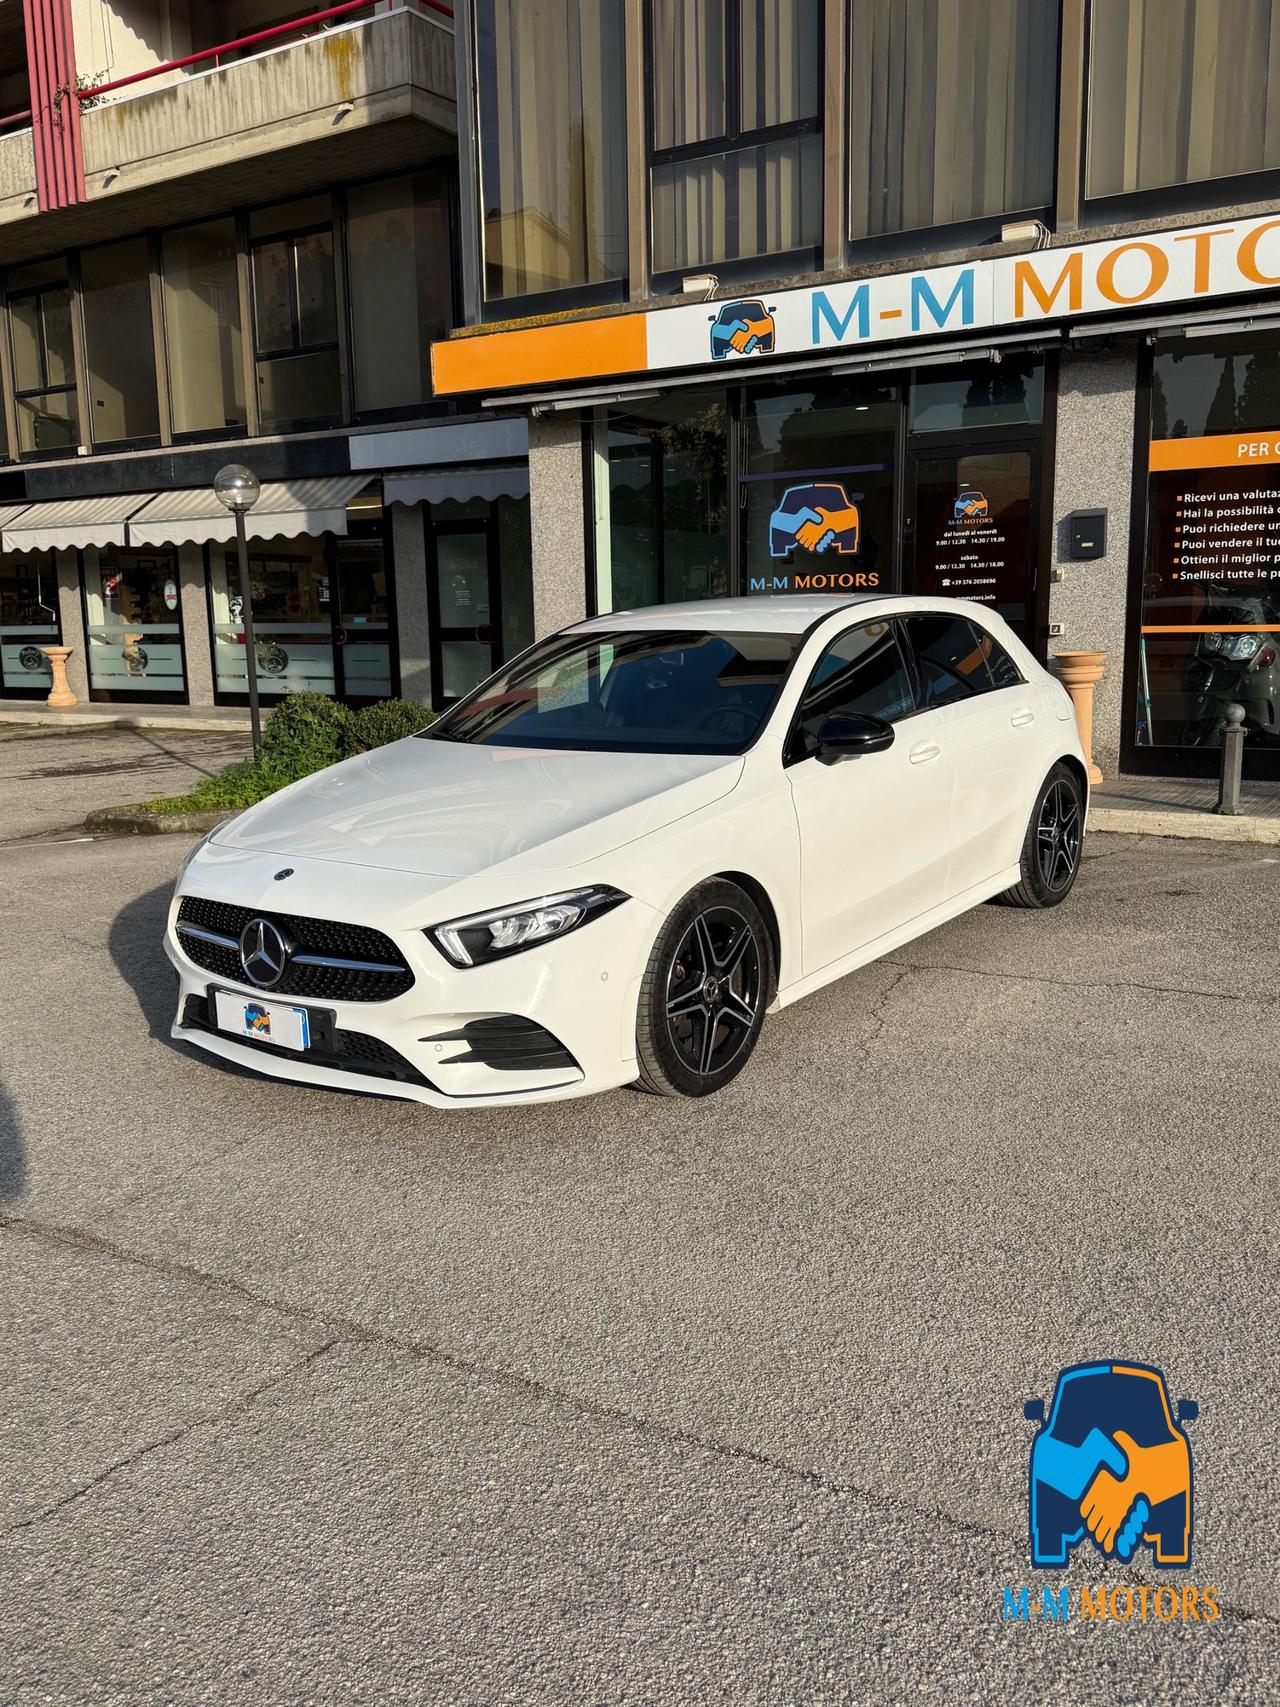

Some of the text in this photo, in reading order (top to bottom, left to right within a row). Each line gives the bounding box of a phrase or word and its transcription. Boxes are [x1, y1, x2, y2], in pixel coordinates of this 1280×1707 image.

[812, 220, 1280, 345] M-M MOTO
[1238, 442, 1269, 458] PER
[1184, 492, 1216, 503] Ricevi
[1219, 492, 1240, 501] una
[1183, 508, 1201, 518] Hai
[1204, 508, 1214, 517] la
[1217, 505, 1274, 518] possibilità
[1182, 524, 1206, 534] Puoi
[1210, 522, 1265, 532] richiedere
[1182, 539, 1206, 549] Puoi
[1208, 538, 1253, 548] vendere
[1256, 537, 1263, 546] il
[1181, 554, 1218, 565] Ottieni
[1222, 554, 1228, 564] il
[1231, 553, 1270, 565] miglior
[1180, 570, 1224, 581] Snellisci
[1227, 570, 1254, 579] tutte
[1257, 569, 1267, 578] le
[750, 572, 879, 591] M-M MOTORS
